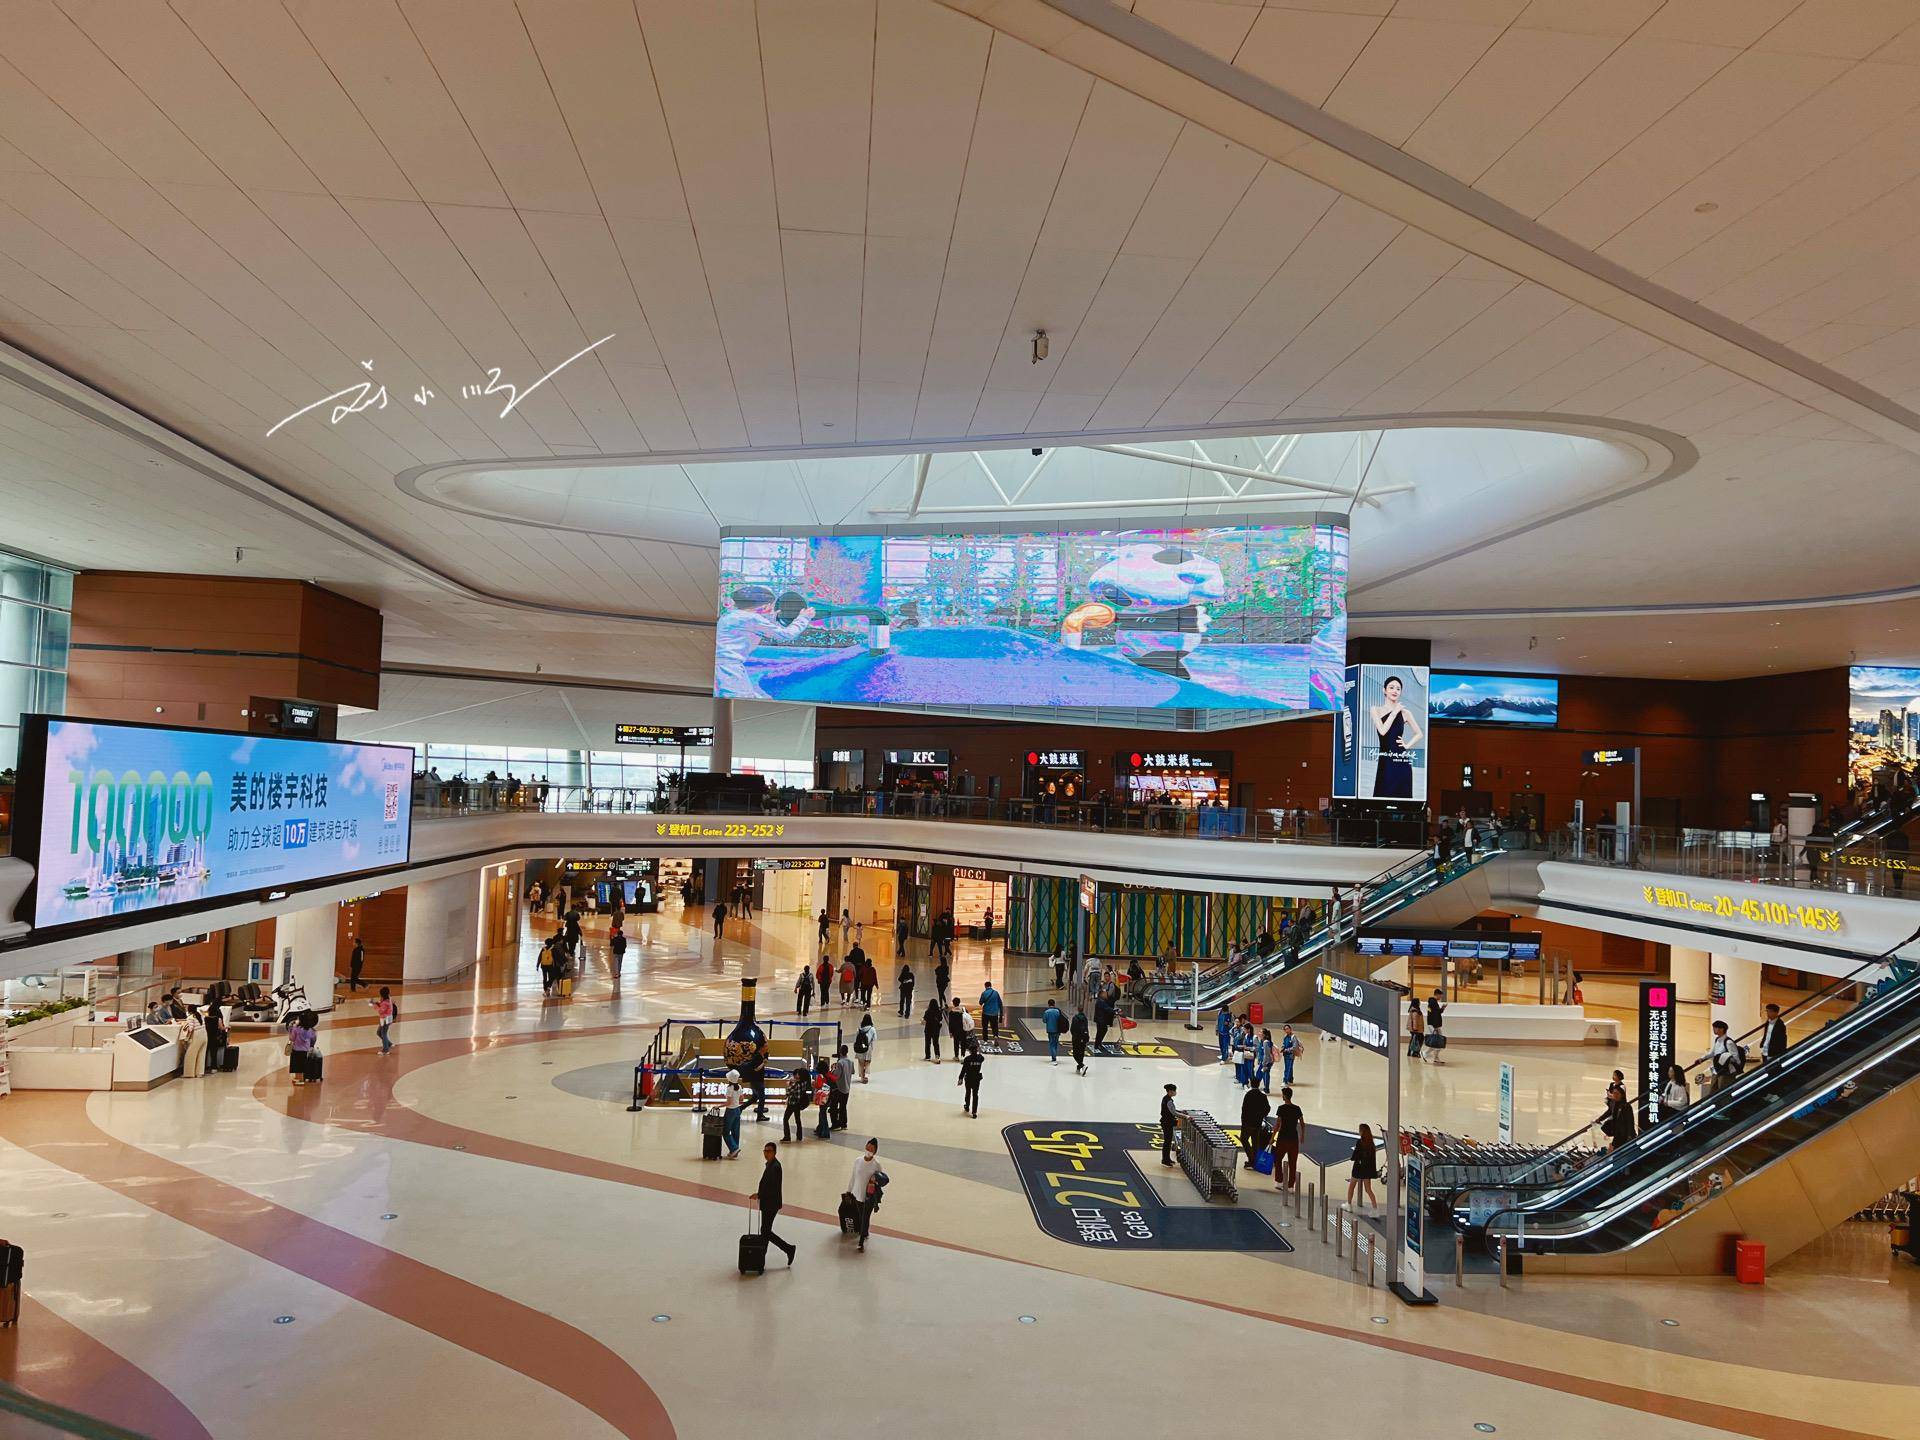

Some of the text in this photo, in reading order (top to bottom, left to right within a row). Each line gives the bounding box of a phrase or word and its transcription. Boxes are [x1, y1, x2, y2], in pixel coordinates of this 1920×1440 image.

[912, 751, 936, 763] KFC
[230, 771, 328, 813] 美的楼宇科技
[668, 824, 774, 837] 登机口 Gates 223-252
[580, 862, 608, 870] 223-252
[851, 857, 888, 869] BVLGARI
[953, 867, 986, 880] GUCCI
[1655, 887, 1688, 909] 登机口
[1690, 899, 1713, 913] Gates
[1024, 1129, 1142, 1208] 27-45
[1071, 1207, 1118, 1242] 登机口
[1120, 1210, 1153, 1239] Gates
